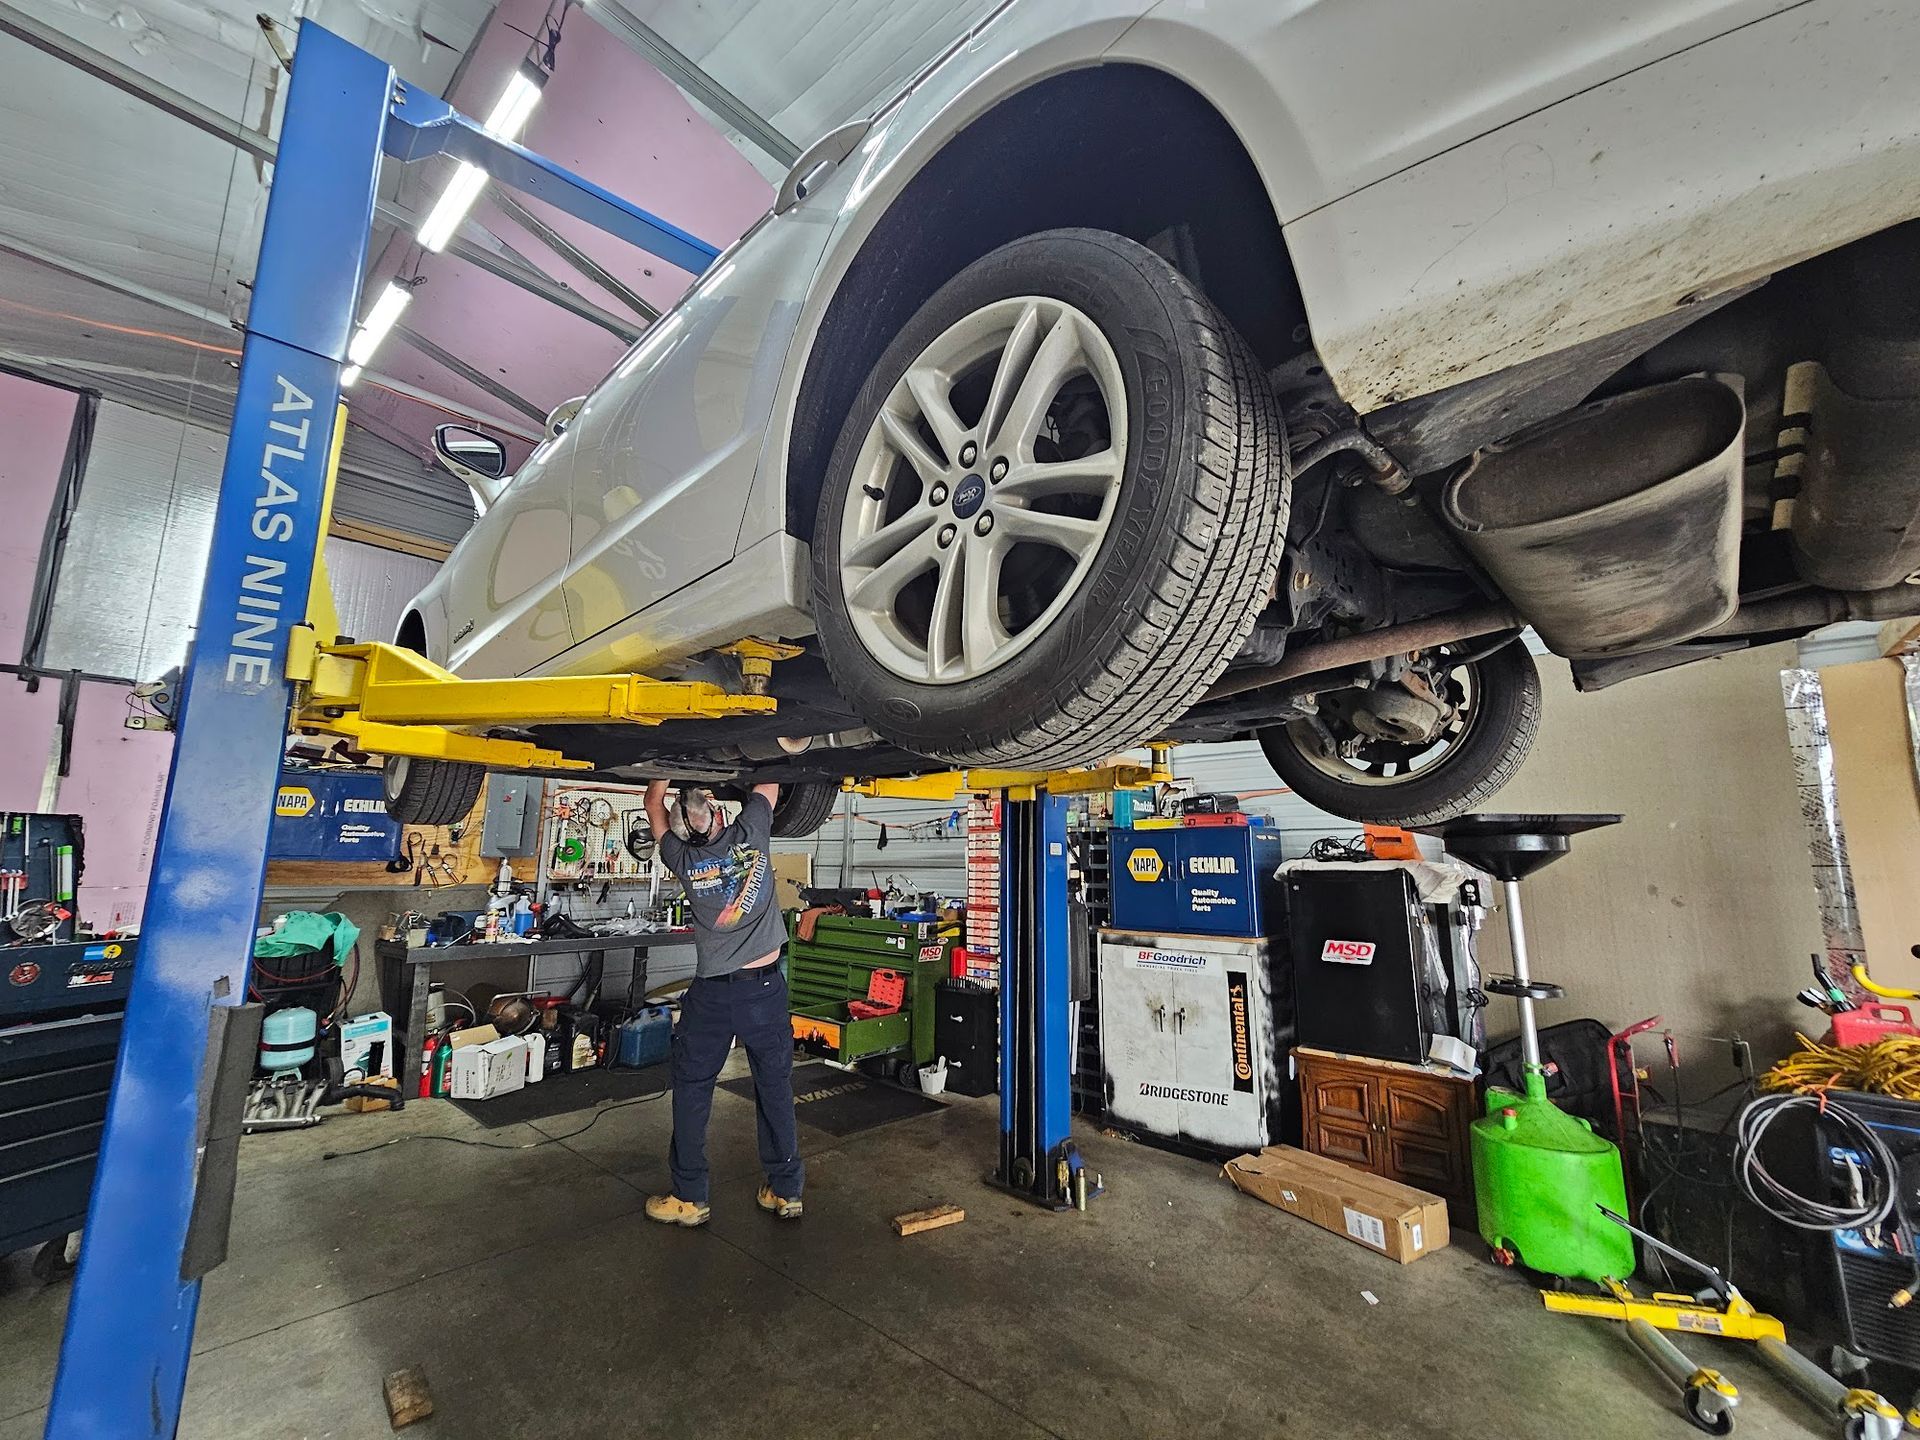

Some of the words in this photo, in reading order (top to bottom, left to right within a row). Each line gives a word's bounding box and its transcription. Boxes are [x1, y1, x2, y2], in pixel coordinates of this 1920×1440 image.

[252, 374, 314, 544] ATLAS
[225, 555, 287, 685] NINE
[278, 795, 307, 808] NAPA
[341, 824, 371, 832] Quality
[1133, 857, 1158, 873] NAPA
[1191, 888, 1220, 898] Quality
[1191, 896, 1237, 905] Automotive
[1191, 903, 1212, 912] Parts
[920, 946, 942, 958] MSD
[1325, 942, 1372, 957] MSD
[1137, 950, 1207, 966] BFGoodrich
[1231, 996, 1252, 1080] Continental
[1139, 1082, 1229, 1107] BRIDGESTONE
